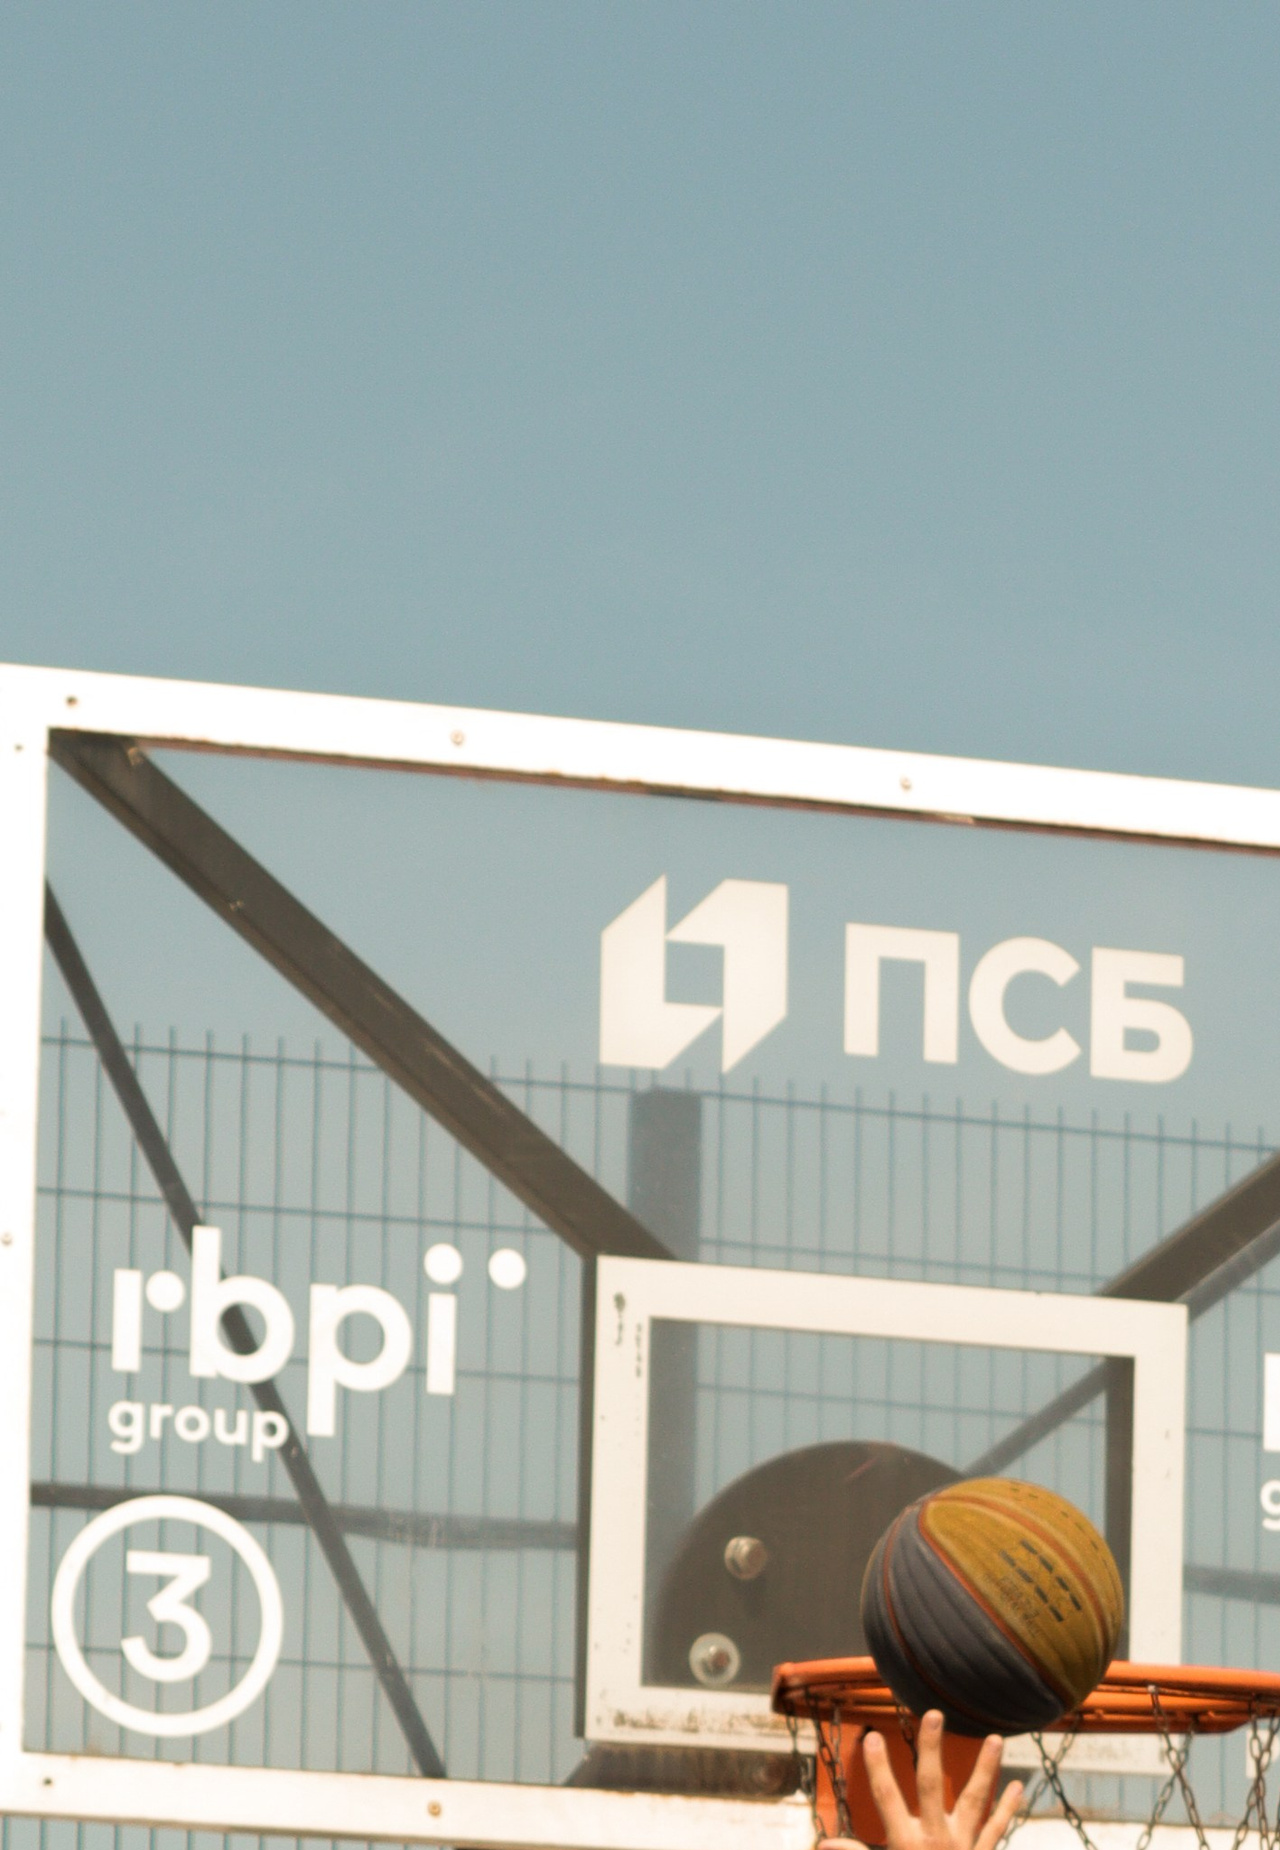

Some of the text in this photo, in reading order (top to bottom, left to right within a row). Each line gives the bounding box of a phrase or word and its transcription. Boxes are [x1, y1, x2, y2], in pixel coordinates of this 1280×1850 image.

[844, 922, 1193, 1083] ПСБ
[108, 1400, 289, 1462] group
[120, 1551, 211, 1682] 3
